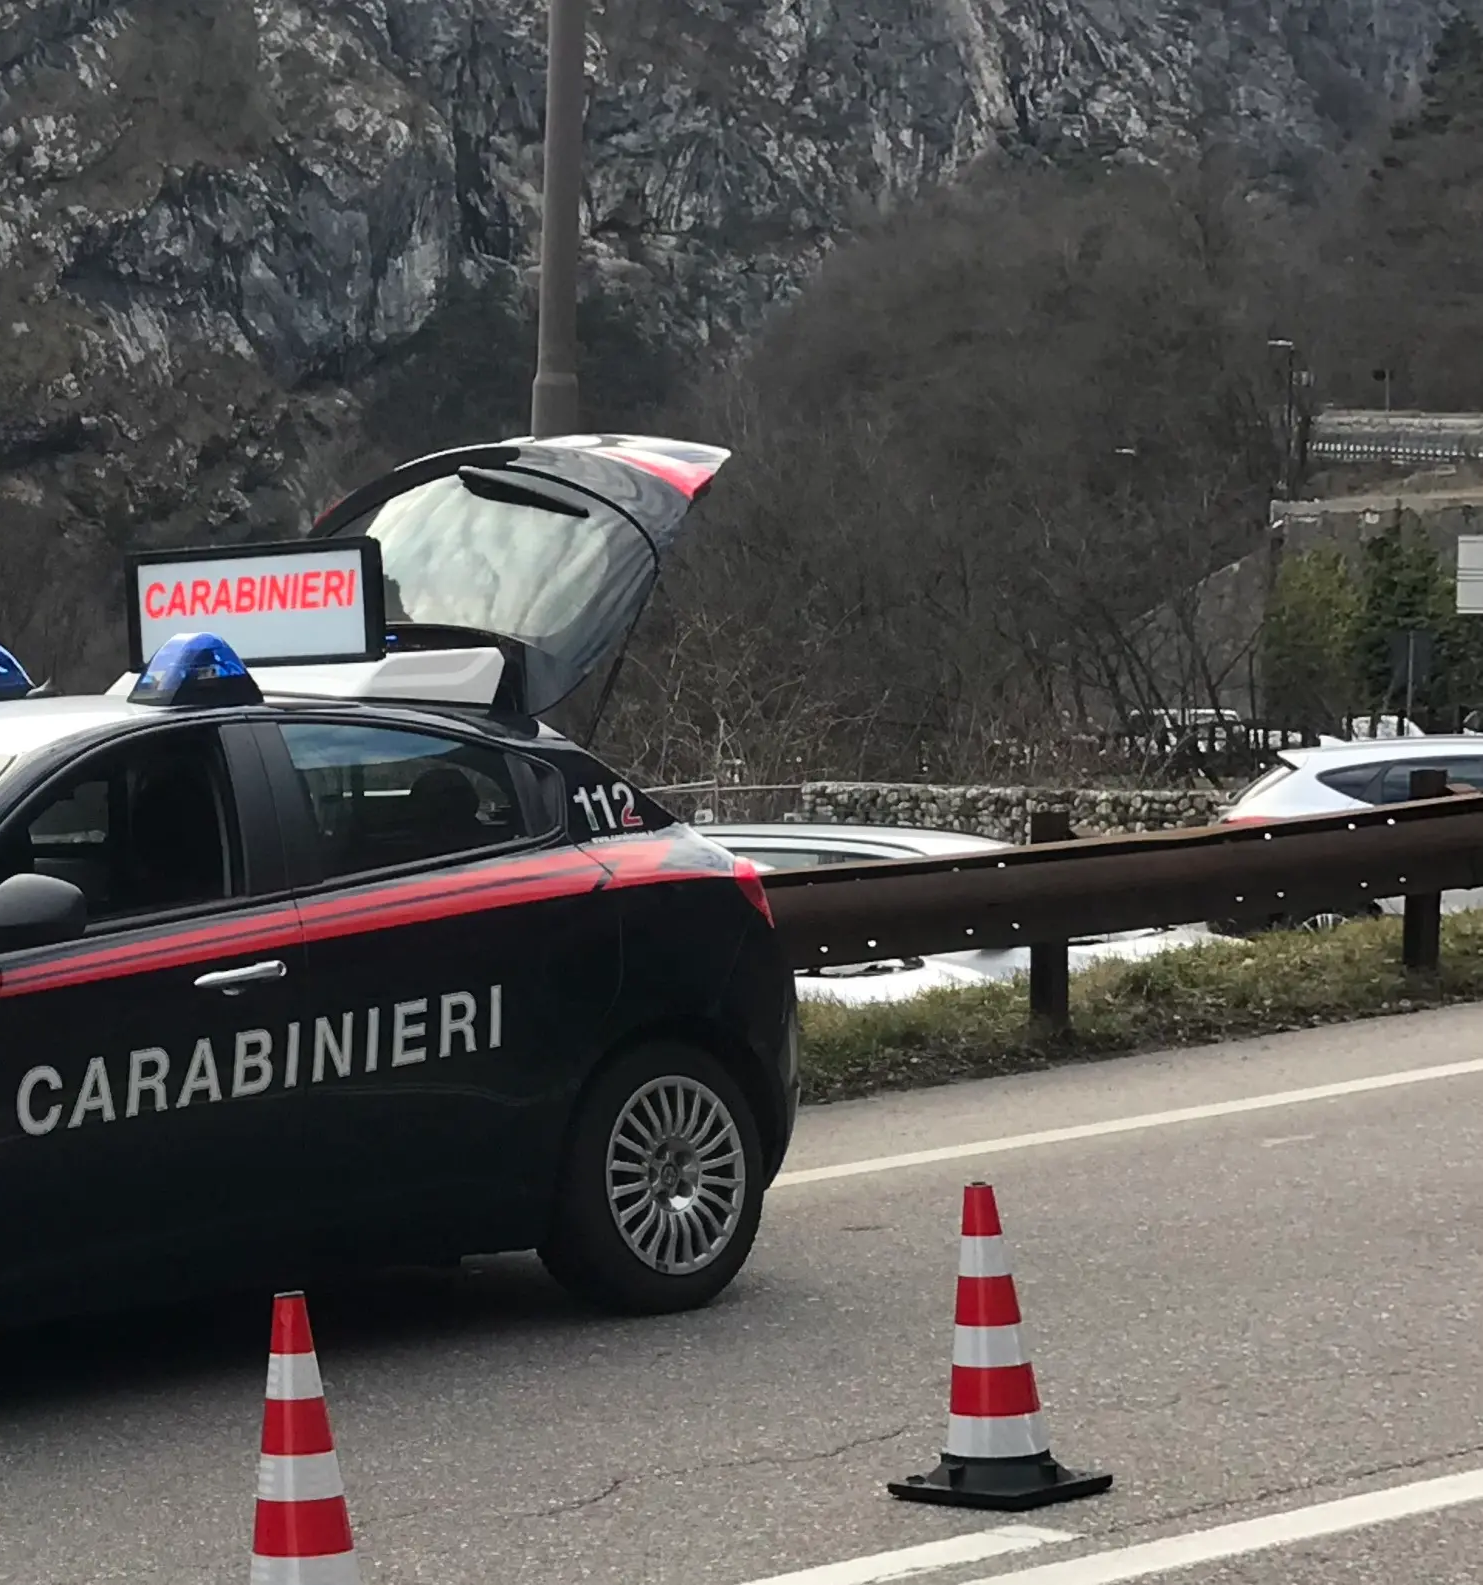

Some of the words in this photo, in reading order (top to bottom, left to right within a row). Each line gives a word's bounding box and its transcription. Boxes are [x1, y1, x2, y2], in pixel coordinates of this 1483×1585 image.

[144, 568, 358, 620] CARABINIERI
[573, 781, 644, 831] 112
[15, 983, 504, 1137] CARABINIERI
